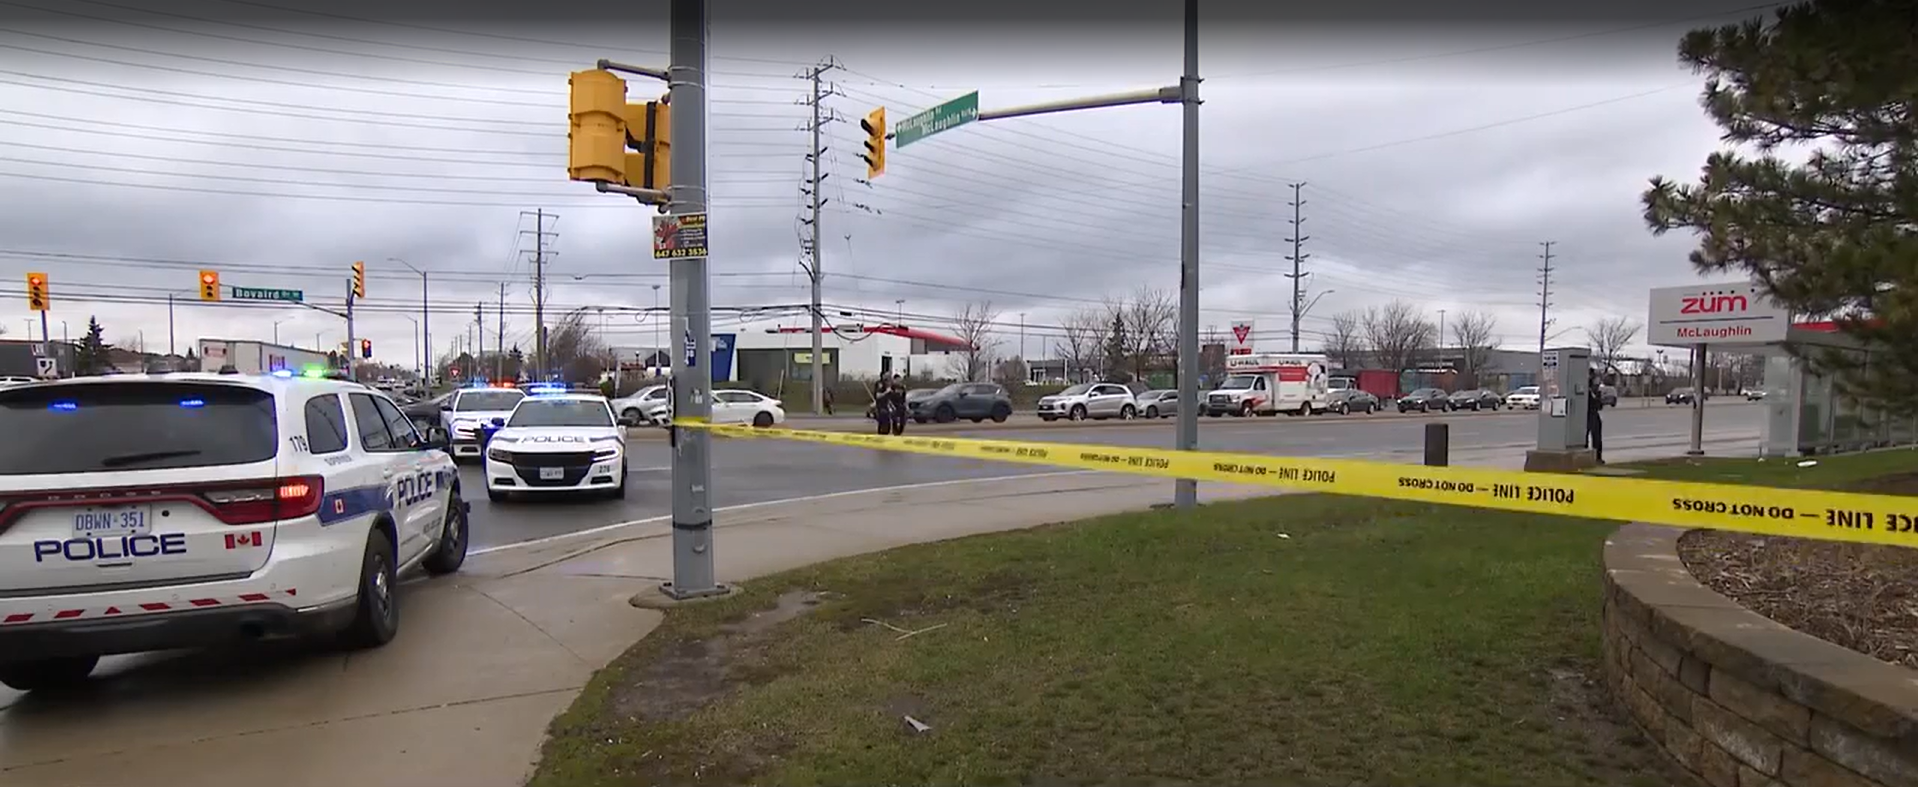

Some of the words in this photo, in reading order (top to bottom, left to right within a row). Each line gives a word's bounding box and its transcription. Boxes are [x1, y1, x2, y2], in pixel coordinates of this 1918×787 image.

[921, 113, 960, 135] McLaughlin
[236, 288, 280, 299] Bovaird
[1677, 325, 1752, 338] McLaughlin
[521, 434, 585, 445] POLICE
[1279, 465, 1298, 480] LINE
[1303, 468, 1335, 483] POLICE
[1398, 476, 1433, 489] CROSS
[1434, 480, 1457, 492] NOT
[1458, 482, 1474, 493] DO
[397, 471, 433, 510] POLICE
[1493, 483, 1520, 499] LINE
[1527, 486, 1575, 504] POLICE
[1673, 498, 1727, 514] CROSS
[1732, 503, 1765, 518] NOT
[1768, 506, 1794, 519] DO
[1826, 509, 1874, 529] LINE
[34, 532, 188, 563] POLICE
